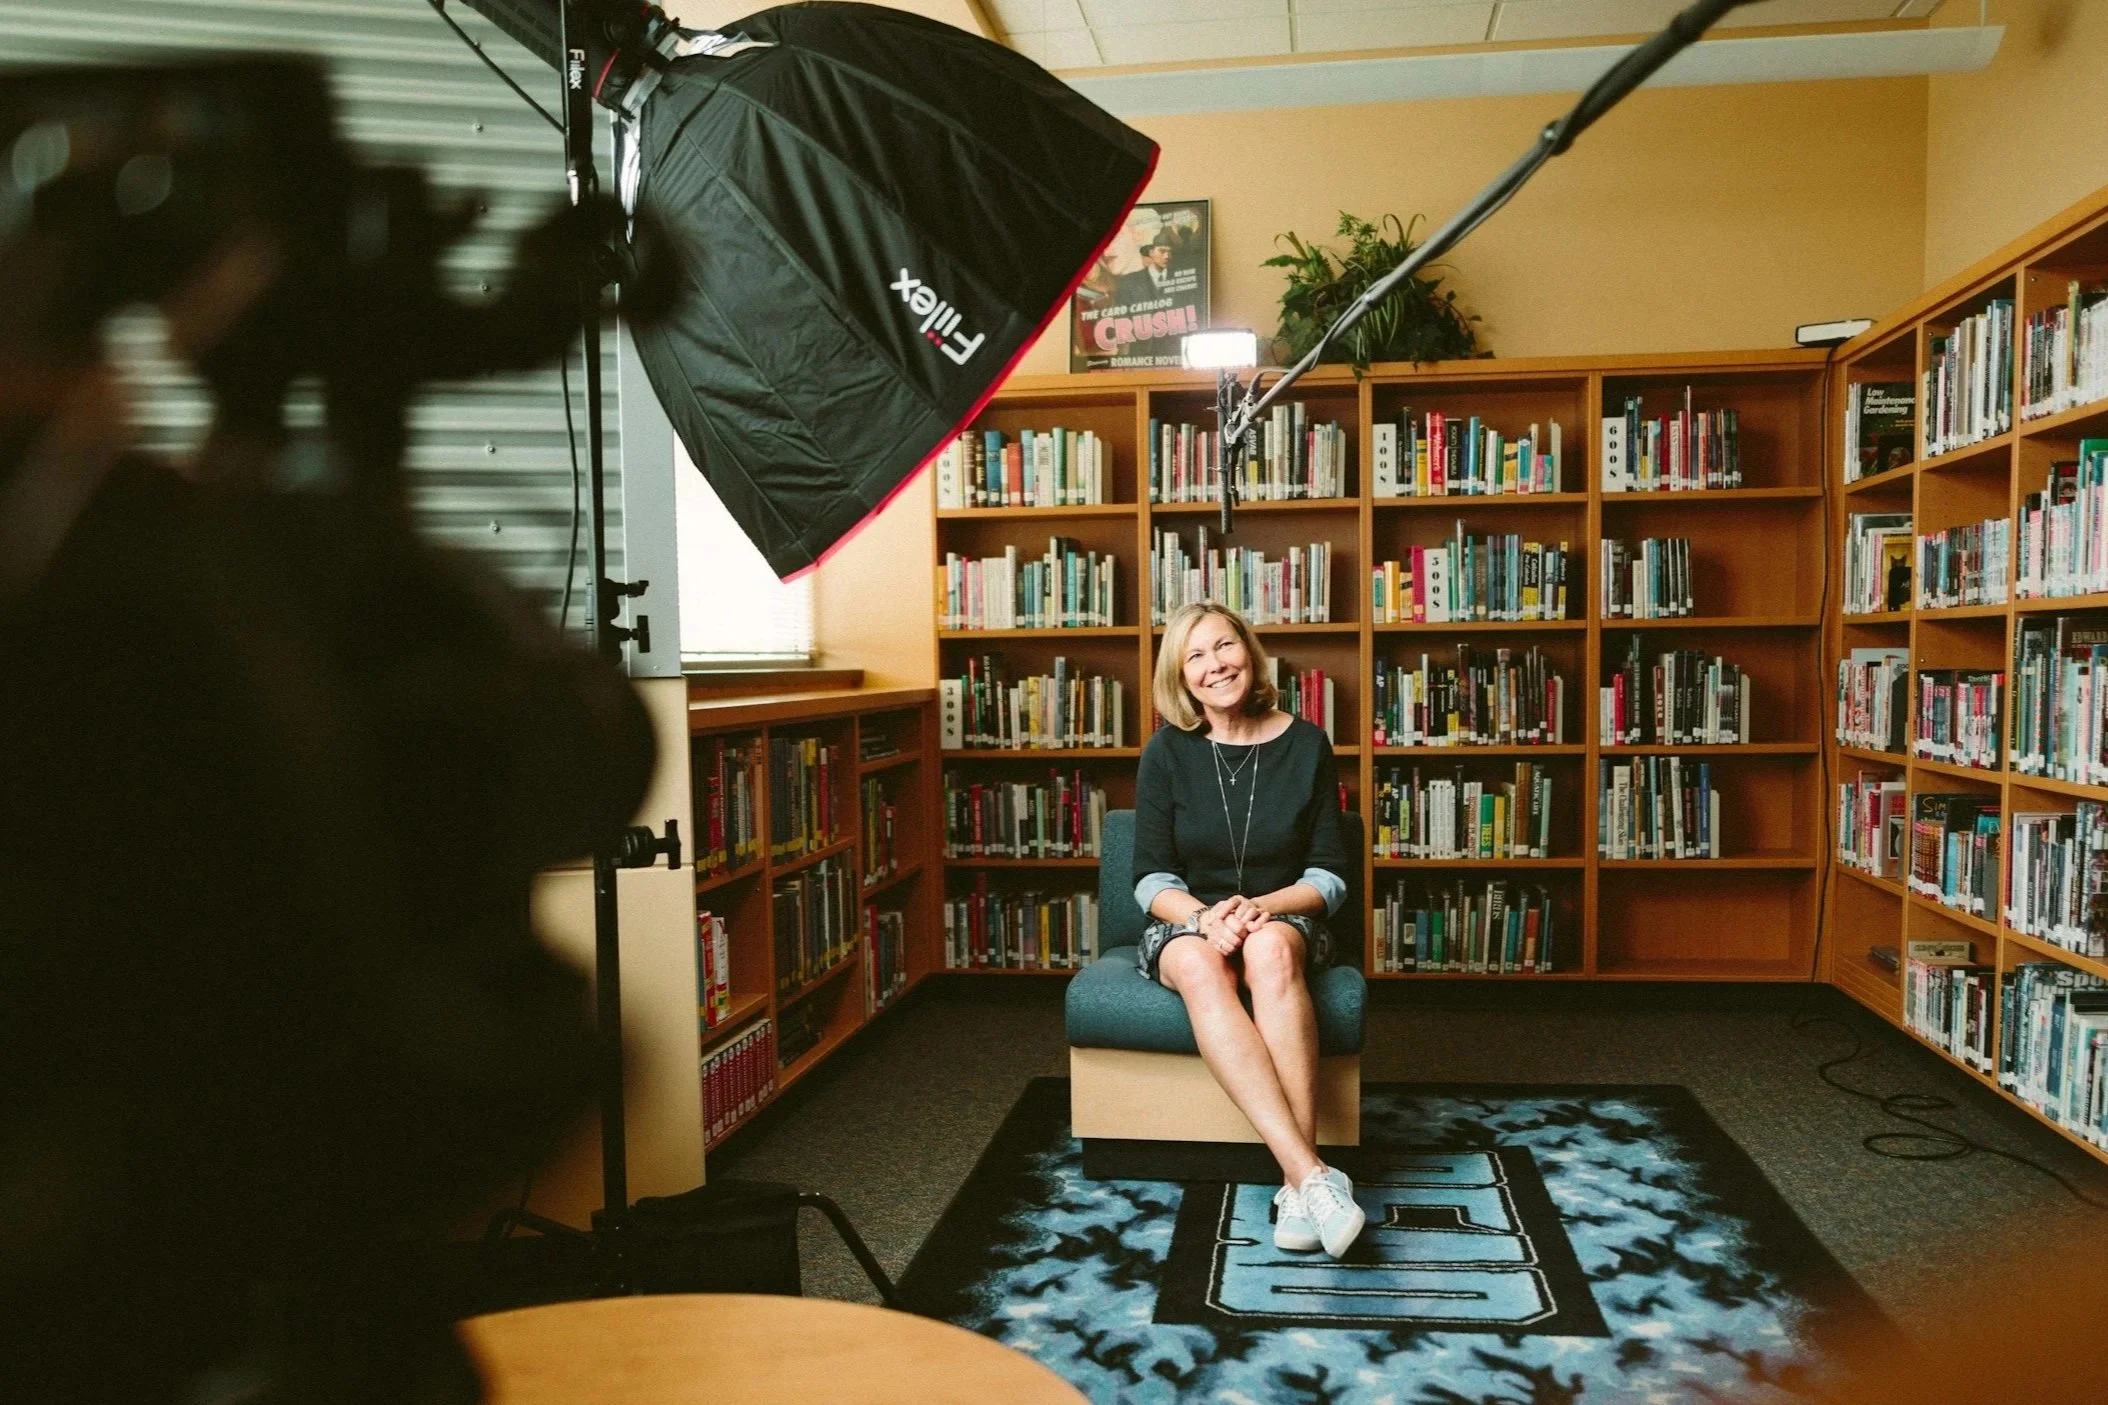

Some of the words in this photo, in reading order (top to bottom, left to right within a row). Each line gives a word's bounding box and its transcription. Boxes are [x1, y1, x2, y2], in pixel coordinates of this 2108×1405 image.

[1081, 310, 1099, 321] THE
[1101, 305, 1128, 318] CARD
[1130, 298, 1174, 313] CATALOG
[890, 268, 986, 366] Fiilex
[1094, 304, 1198, 351] CRUSH!
[1111, 356, 1154, 367] ROMANCE
[1155, 355, 1182, 366] NOVE
[1867, 387, 1885, 396] Low
[1865, 396, 1916, 406] Maintenanc
[1863, 405, 1909, 416] Gardening
